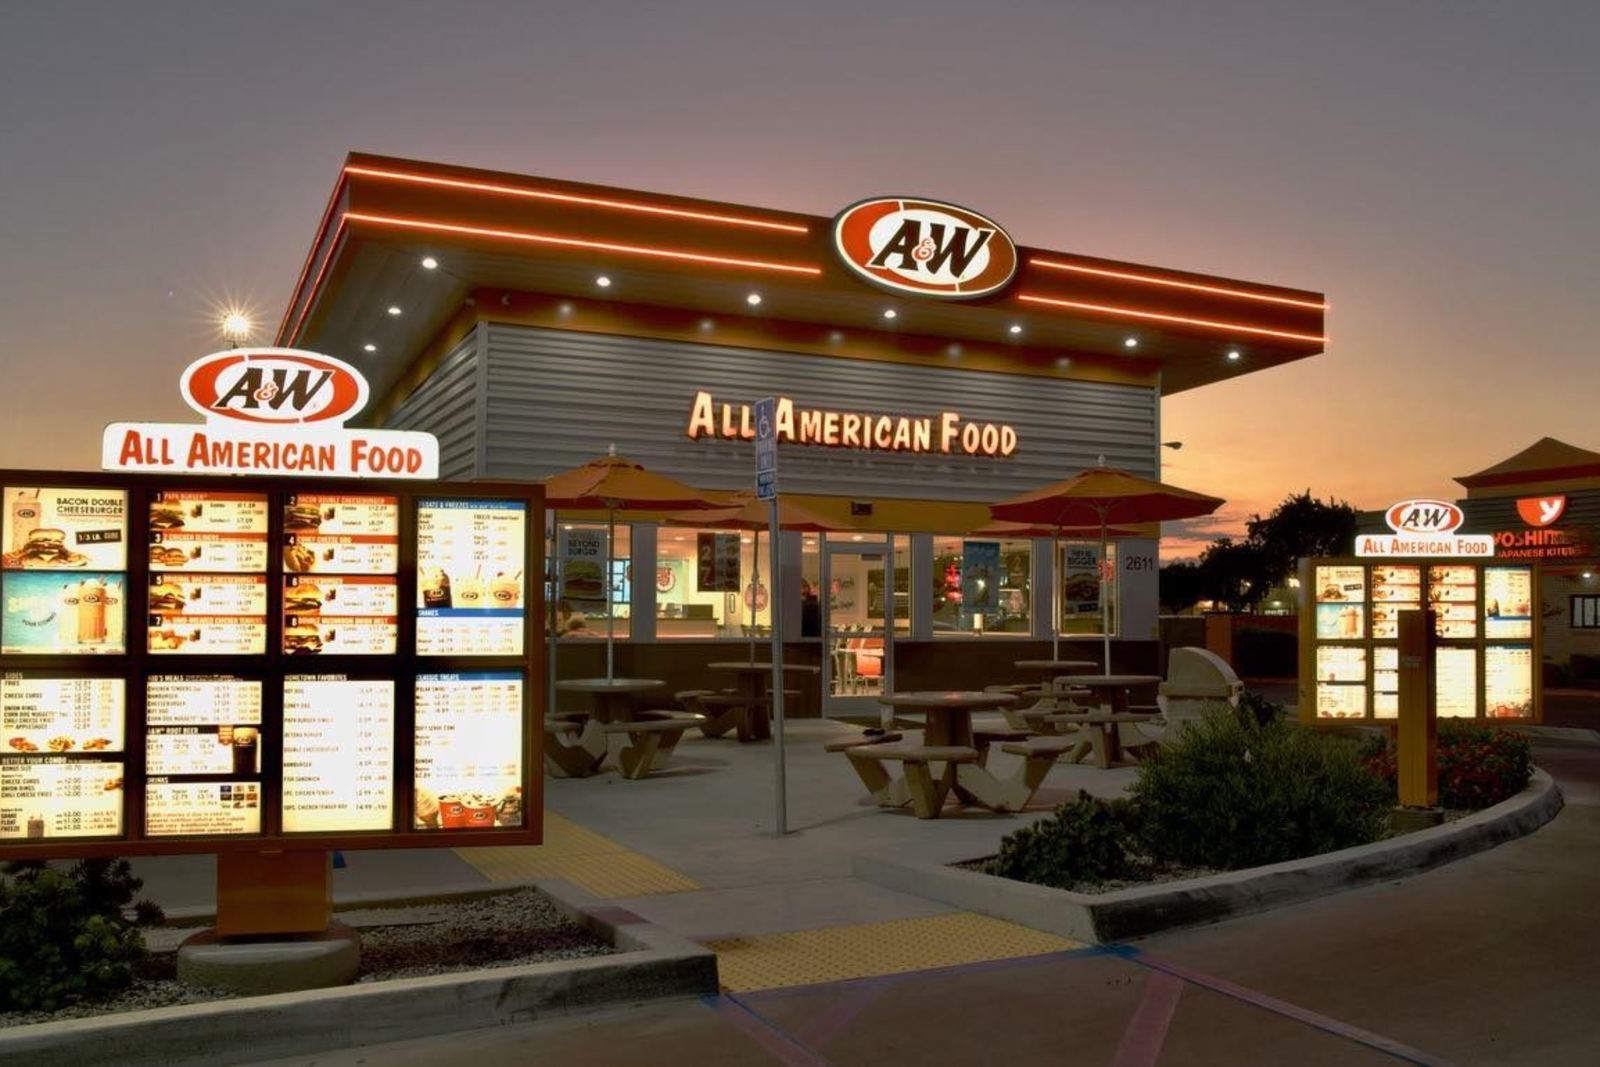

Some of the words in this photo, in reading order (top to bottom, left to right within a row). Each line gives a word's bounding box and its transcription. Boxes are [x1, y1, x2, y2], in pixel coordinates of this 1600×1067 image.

[867, 218, 995, 279] A&W
[213, 367, 333, 411] A&W
[688, 390, 756, 438] ALL
[775, 397, 931, 451] AMERICAN
[941, 412, 1017, 456] FOOD
[119, 429, 174, 466] ALL
[186, 432, 335, 471] AMERICAN
[351, 439, 423, 474] FOOD
[57, 498, 89, 506] BACON
[91, 498, 123, 506] DOUBLE
[57, 506, 123, 514] CHEESEBURGER
[155, 533, 161, 543] 3
[289, 536, 295, 544] 4
[1363, 538, 1384, 554] ALL
[1390, 538, 1451, 554] AMERICAN
[1457, 539, 1488, 554] FOOD
[1126, 556, 1153, 571] 2611
[156, 617, 161, 625] 7
